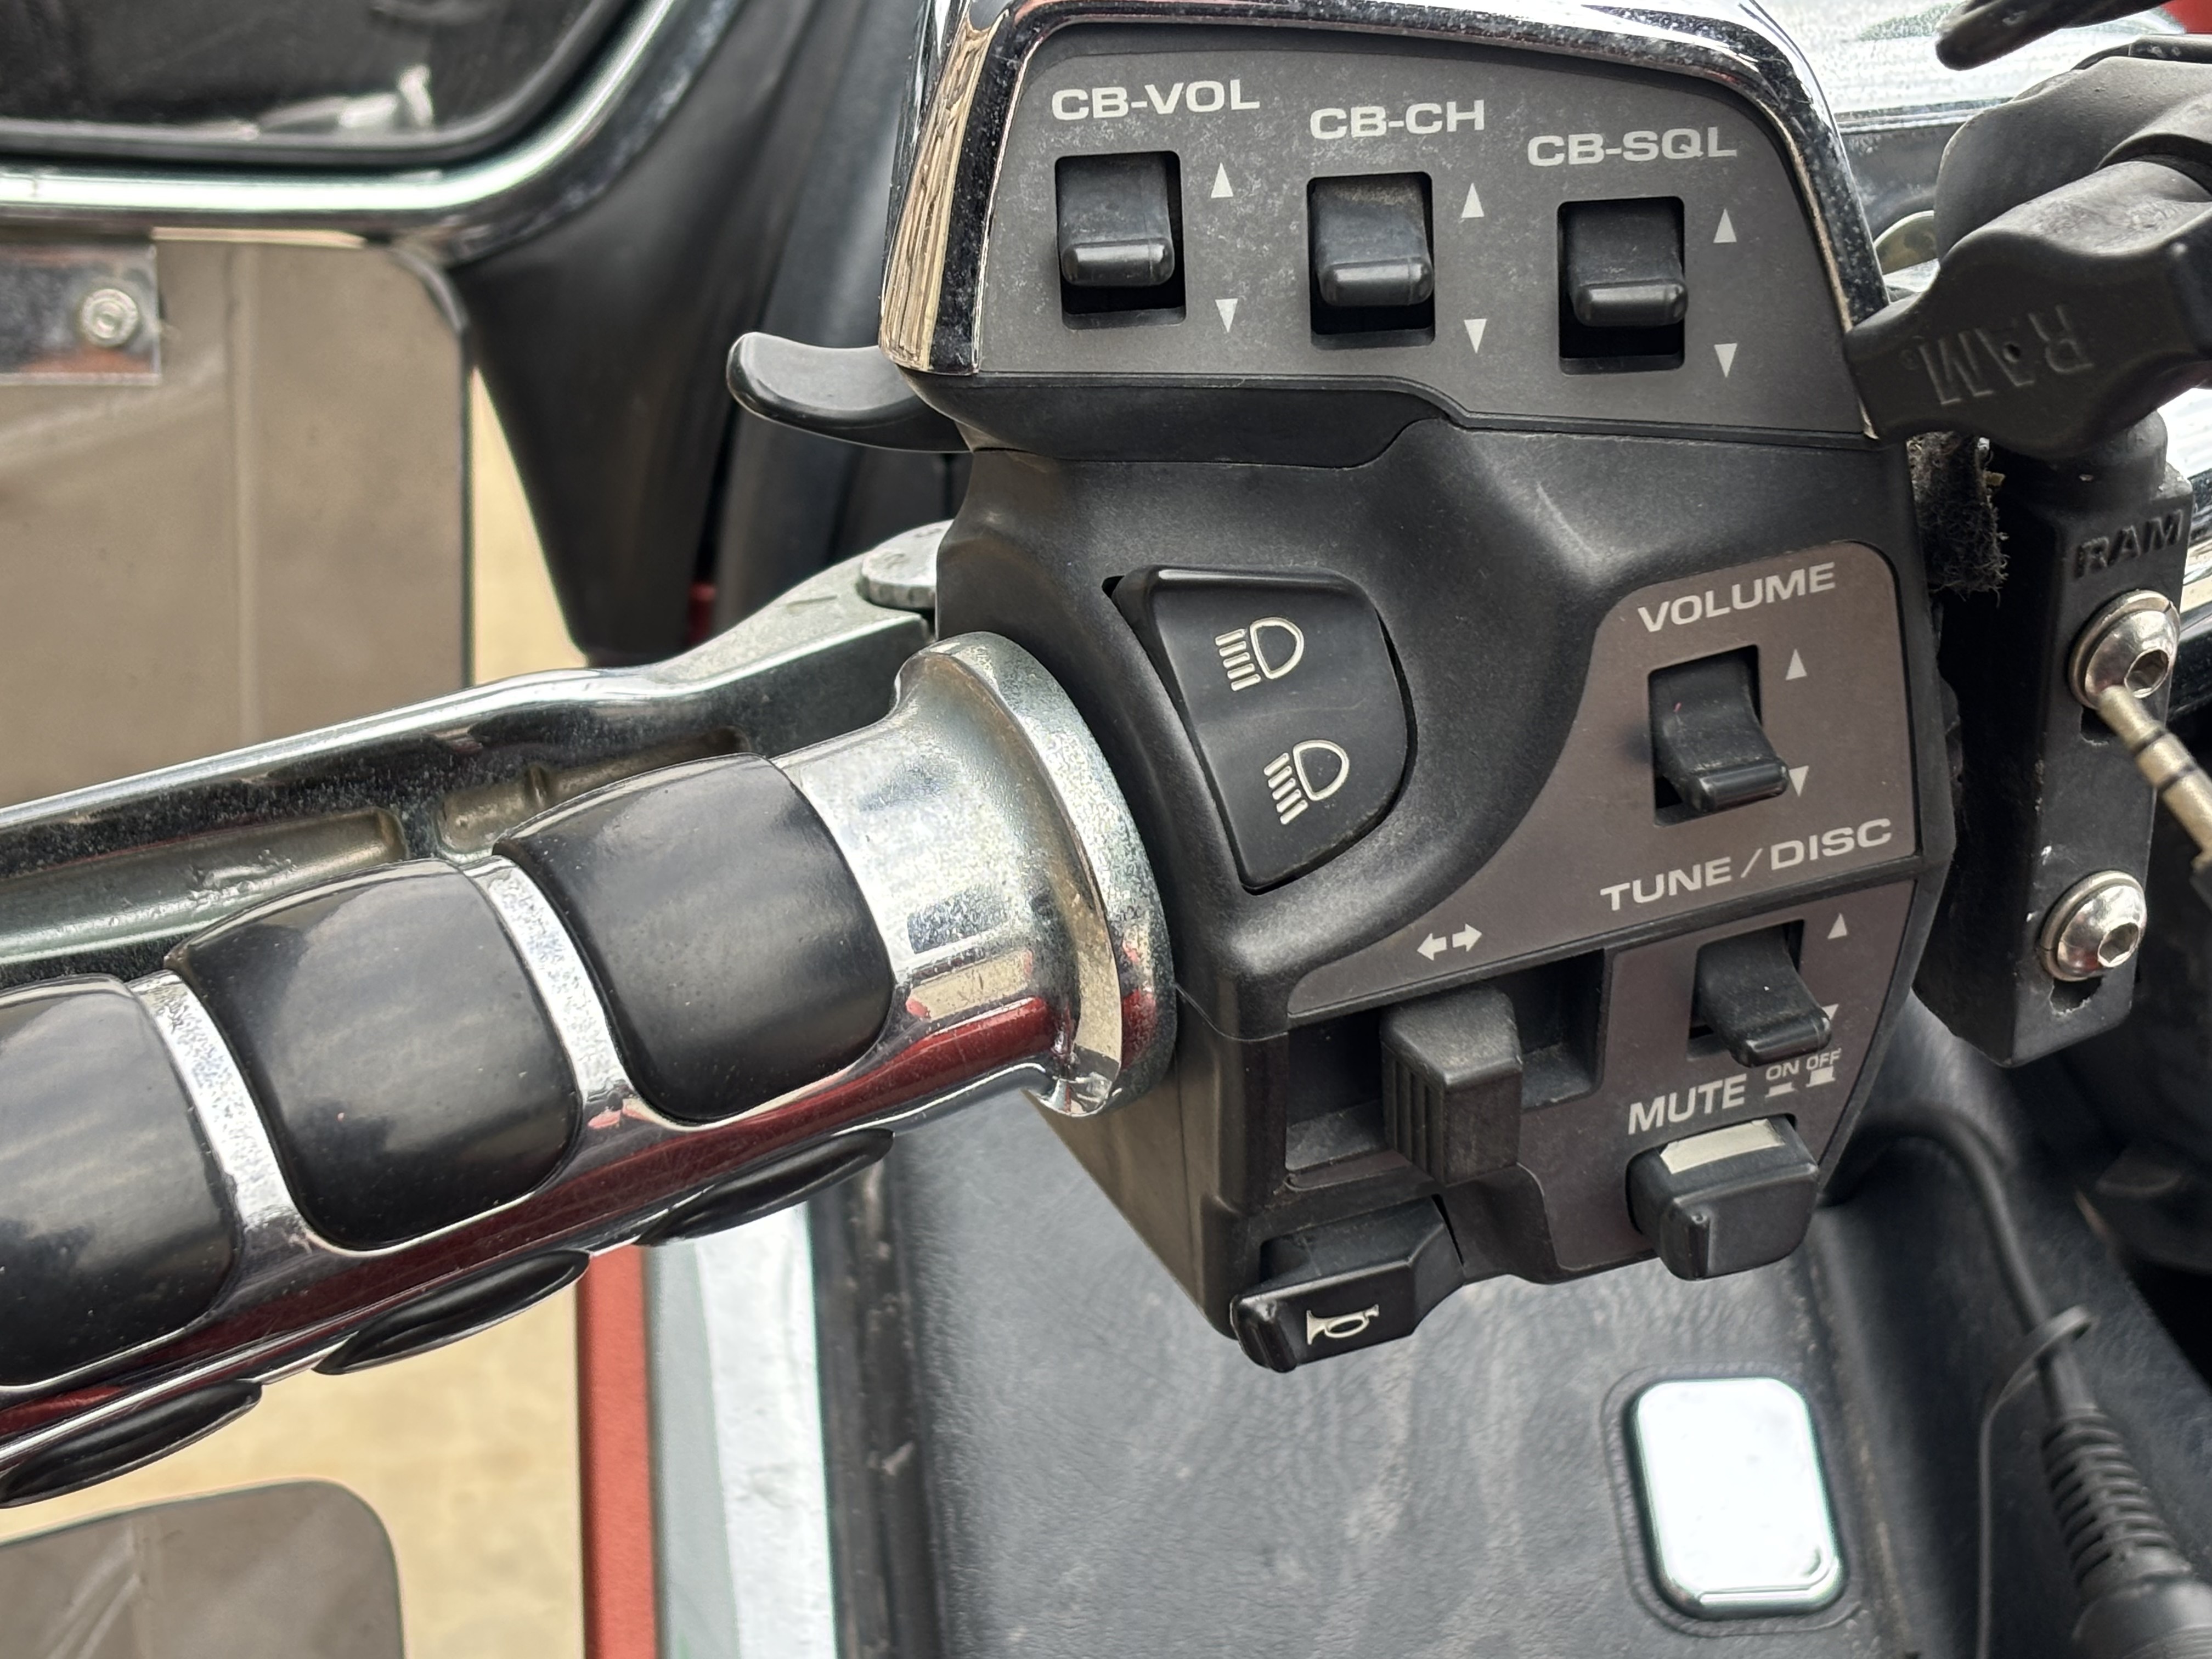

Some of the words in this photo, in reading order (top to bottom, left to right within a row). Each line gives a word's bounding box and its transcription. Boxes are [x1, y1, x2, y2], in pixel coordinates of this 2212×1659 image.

[1051, 79, 1261, 121] CB-VOL
[1310, 99, 1486, 140] CB-CH
[1527, 127, 1737, 167] CB-SQL
[2074, 509, 2183, 579] RAM
[1638, 562, 1836, 633] VOLUME
[1765, 1060, 1799, 1081] ON
[1805, 1048, 1842, 1070] OFF
[1628, 1074, 1747, 1135] MUTE
